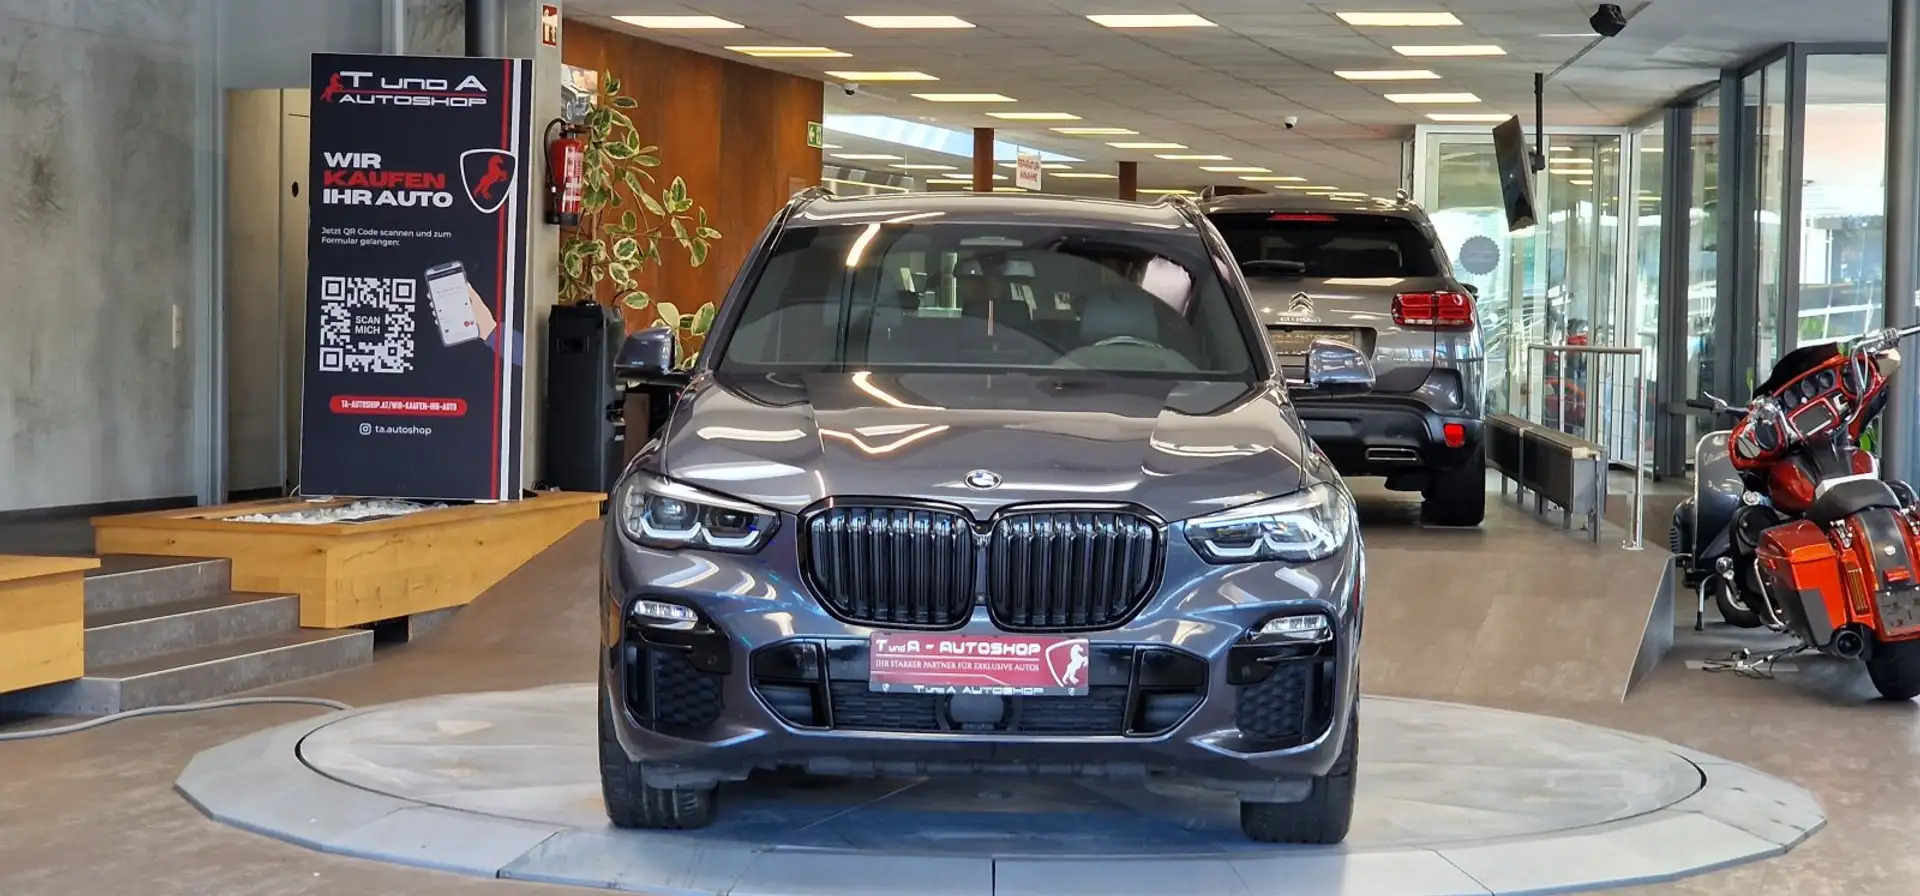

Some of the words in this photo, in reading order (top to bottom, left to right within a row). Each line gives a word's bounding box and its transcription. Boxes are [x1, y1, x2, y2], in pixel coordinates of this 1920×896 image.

[340, 71, 373, 88] T
[454, 75, 488, 92] A
[339, 94, 487, 107] AUTOSHOP
[323, 152, 382, 169] WIR
[323, 170, 445, 189] KAUFEN
[323, 188, 374, 205] IHR
[375, 190, 454, 208] AUTO
[321, 227, 341, 235] Jetzt
[343, 228, 356, 236] QR
[357, 228, 378, 236] Code
[416, 229, 432, 237] und
[321, 236, 358, 244] Formular
[360, 238, 400, 247] gelangen:
[355, 316, 380, 324] SCAN
[355, 325, 380, 334] MICH
[375, 425, 432, 436] ta.autoshop
[940, 641, 1041, 656] AUTOSHOP
[875, 660, 889, 668] IHR
[890, 660, 921, 669] STARKER
[922, 661, 956, 669] PARTNER
[957, 661, 972, 670] FÜR
[974, 662, 1013, 671] EXKLUSIVE
[1014, 663, 1039, 672] AUTOS
[962, 686, 1044, 695] AUTOSHOP
